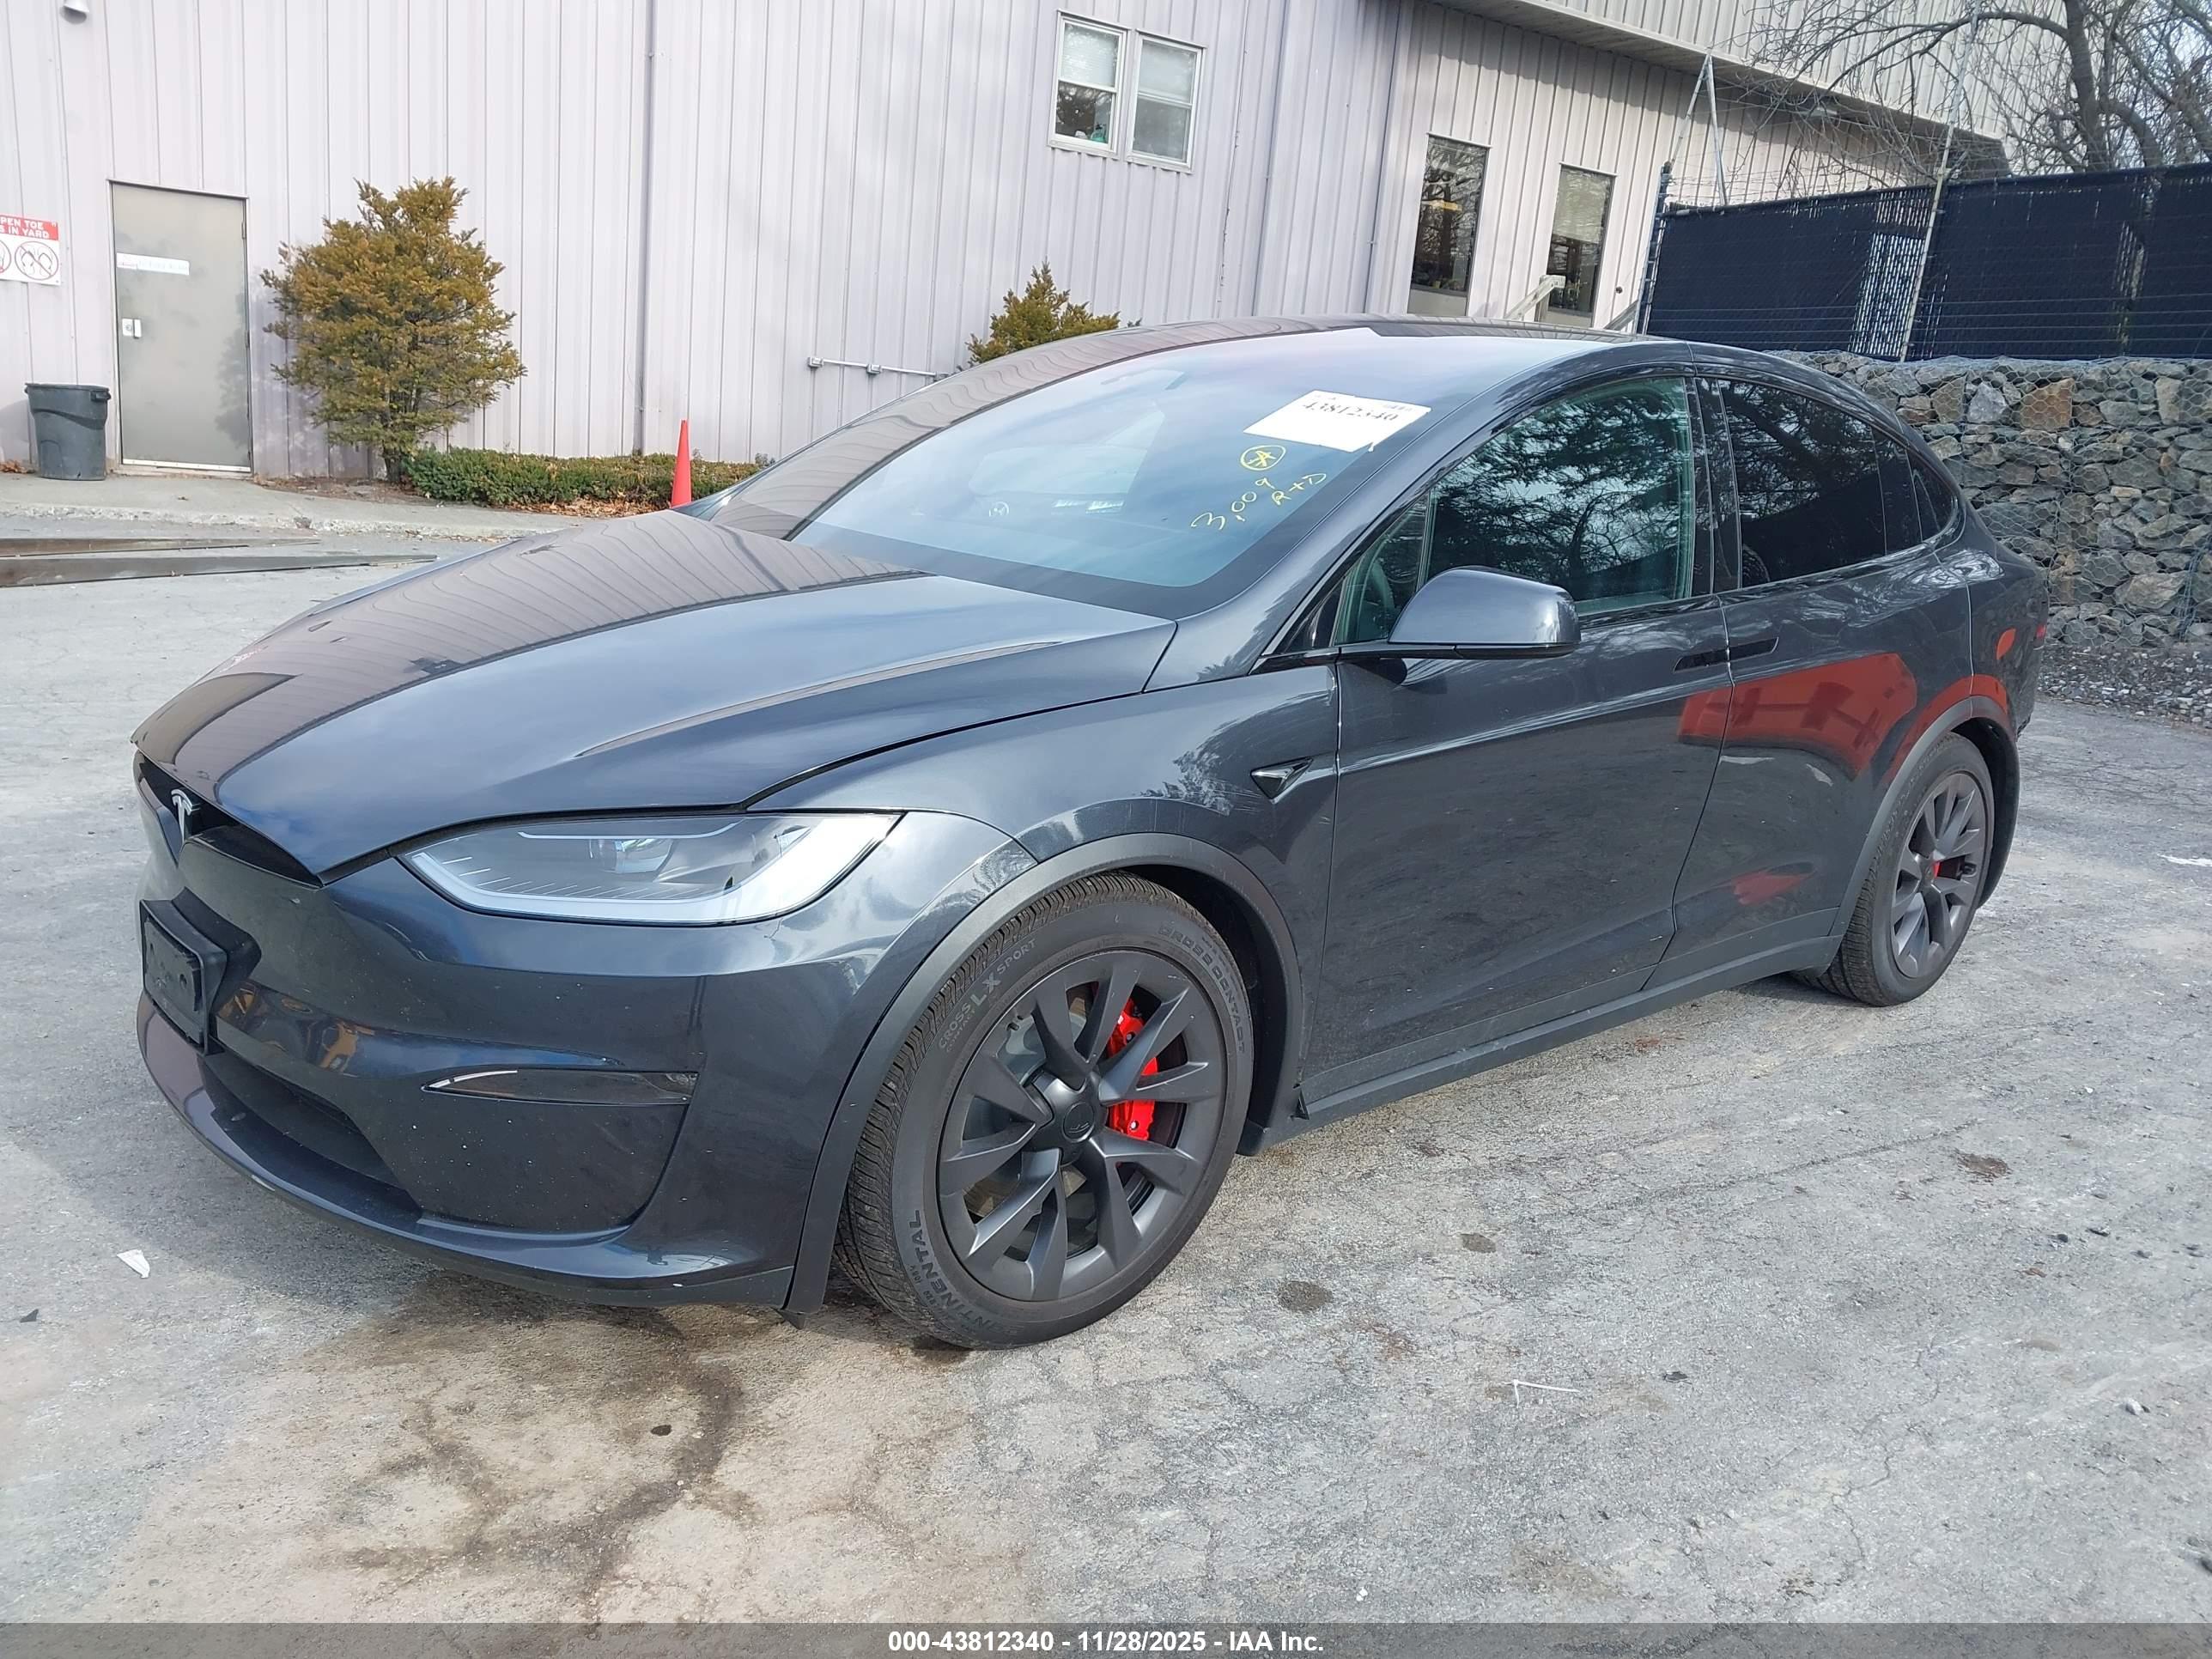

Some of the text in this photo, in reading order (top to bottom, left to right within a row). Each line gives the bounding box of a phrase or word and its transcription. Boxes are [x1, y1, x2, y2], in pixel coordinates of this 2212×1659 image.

[0, 216, 44, 230] PEN TOE
[8, 225, 19, 235] IN
[22, 228, 50, 238] YARD
[939, 1001, 971, 1048] CROSS
[996, 938, 1037, 975] SPORT
